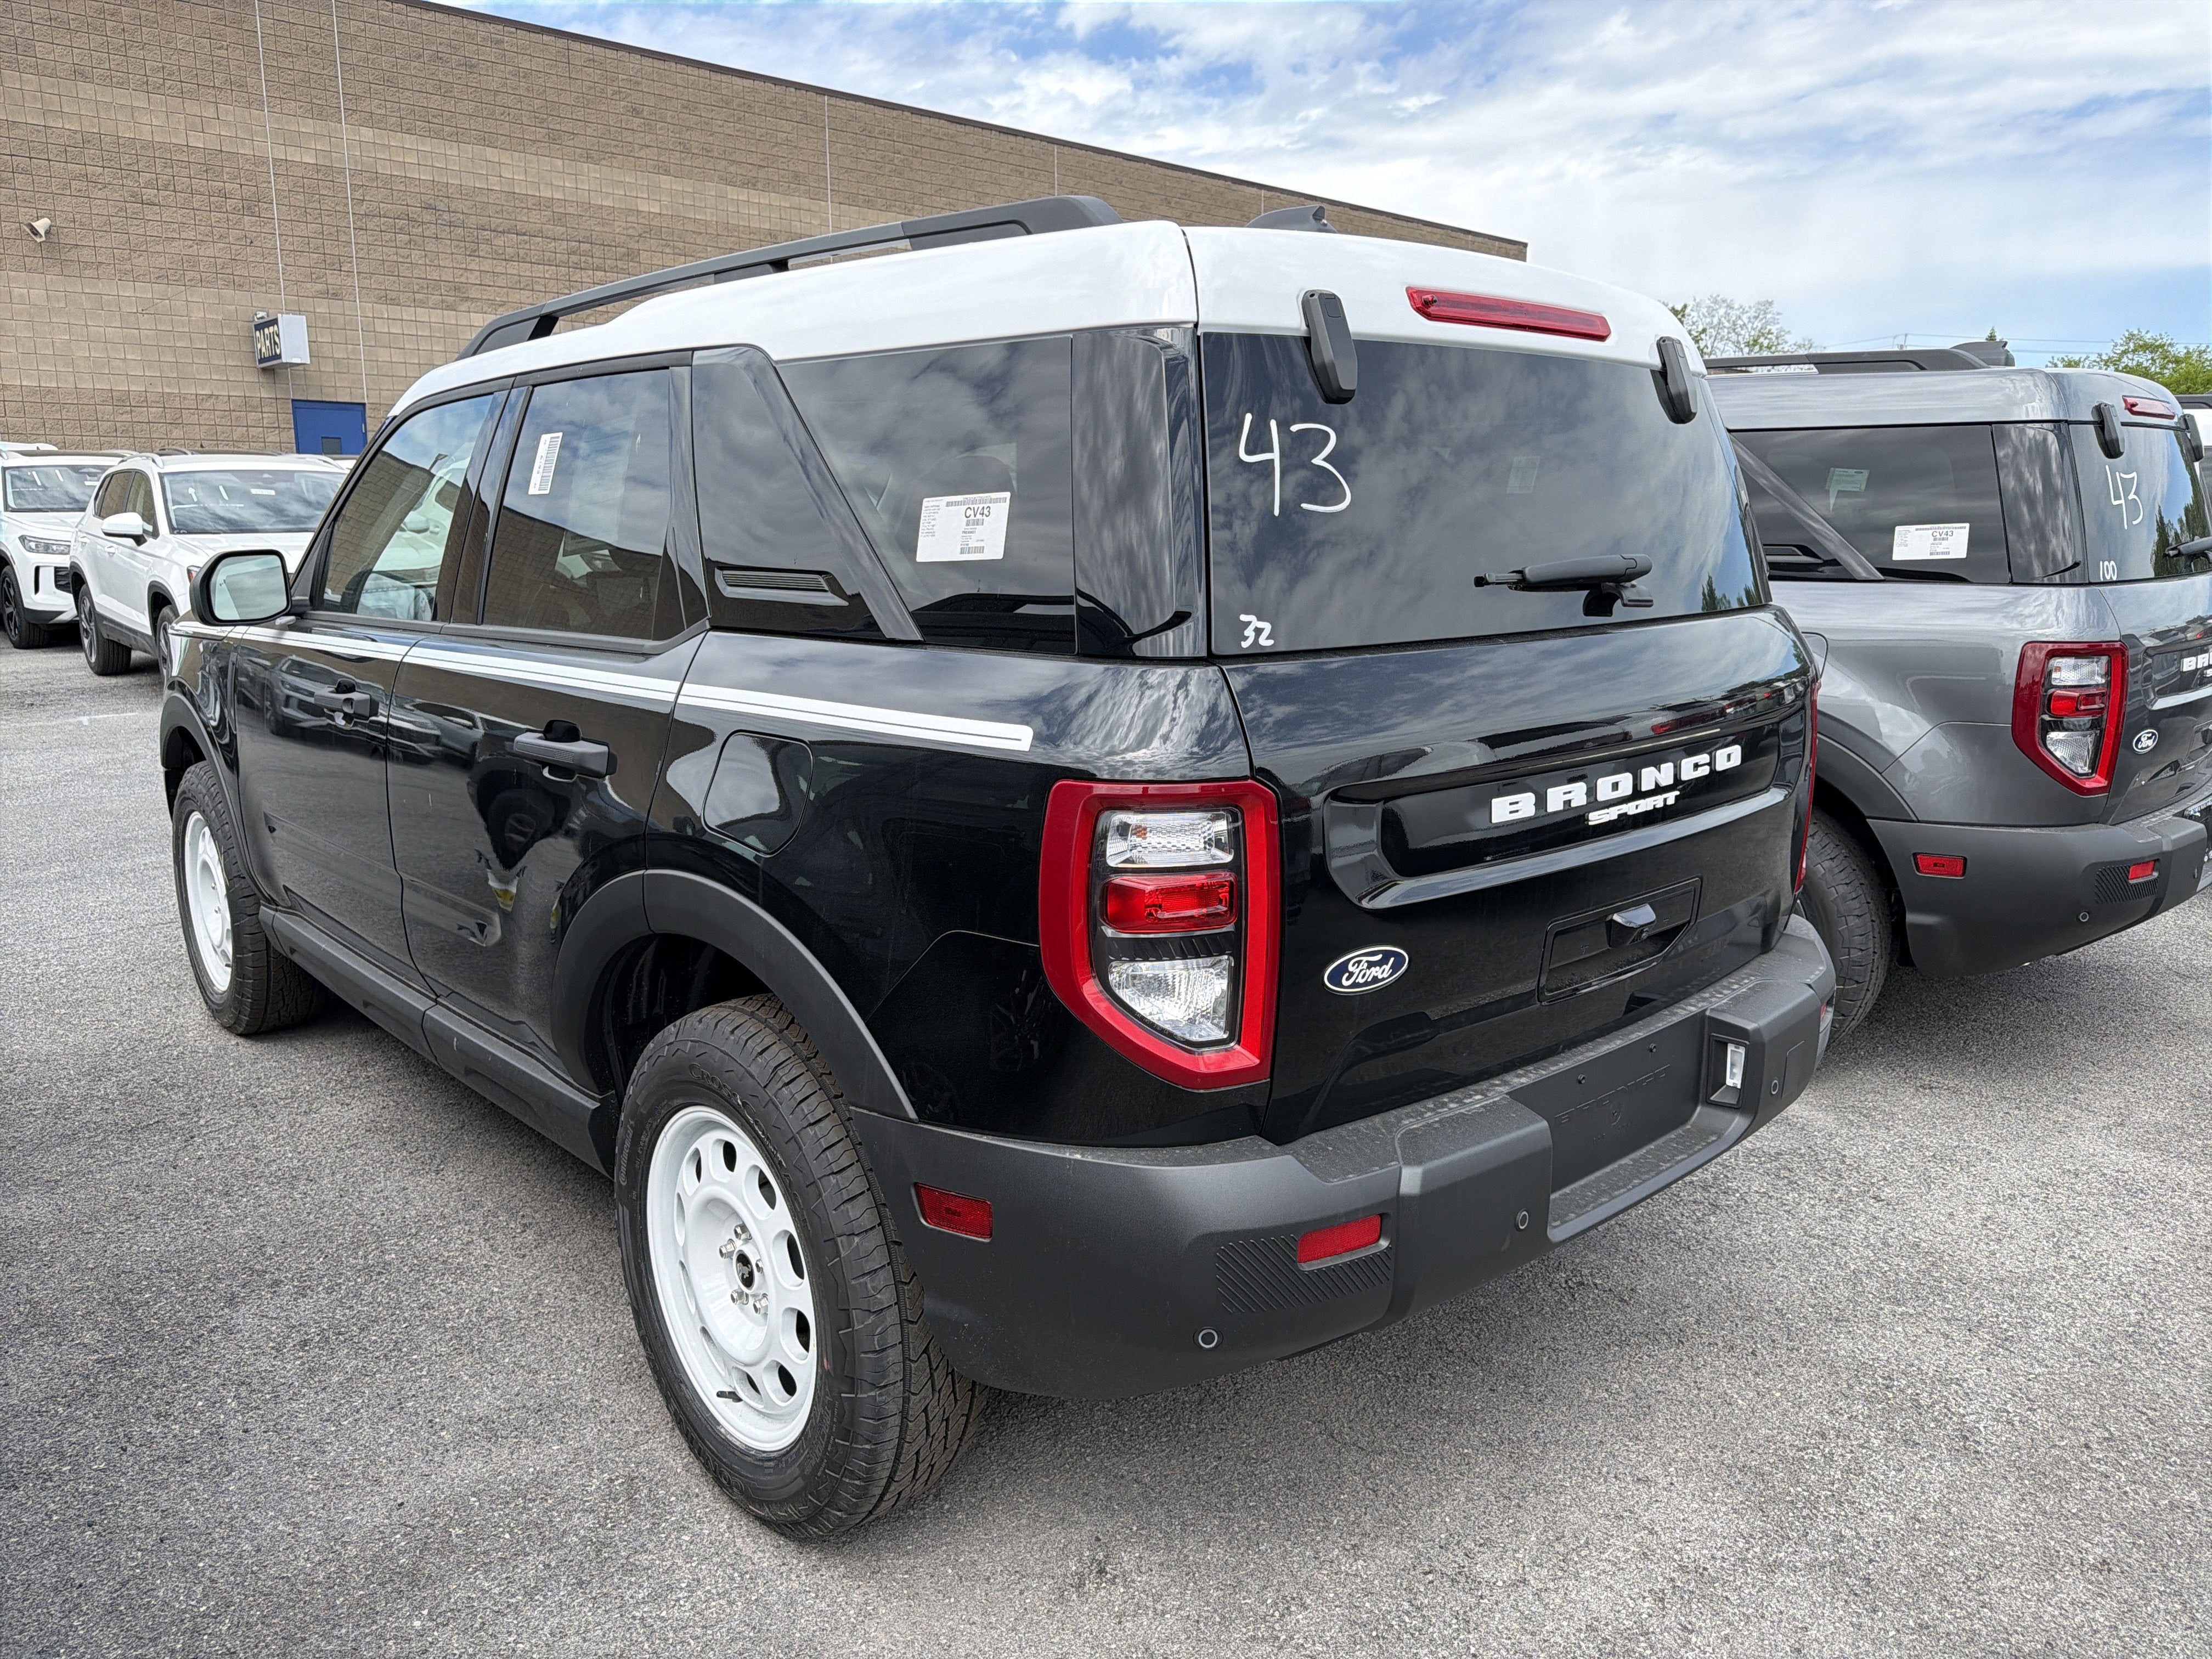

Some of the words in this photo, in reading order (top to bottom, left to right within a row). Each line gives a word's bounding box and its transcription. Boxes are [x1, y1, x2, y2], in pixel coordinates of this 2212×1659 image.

[256, 324, 280, 358] PARTS
[1238, 413, 1352, 517] 43
[964, 506, 991, 518] CV43
[2104, 464, 2143, 530] 43
[2100, 560, 2118, 581] 100
[1239, 614, 1274, 648] 32
[2138, 733, 2155, 748] Ford
[1490, 744, 1741, 823] BRONCO
[1585, 791, 1680, 825] SPORT
[1341, 953, 1395, 986] Ford
[619, 1124, 634, 1186] Continental
